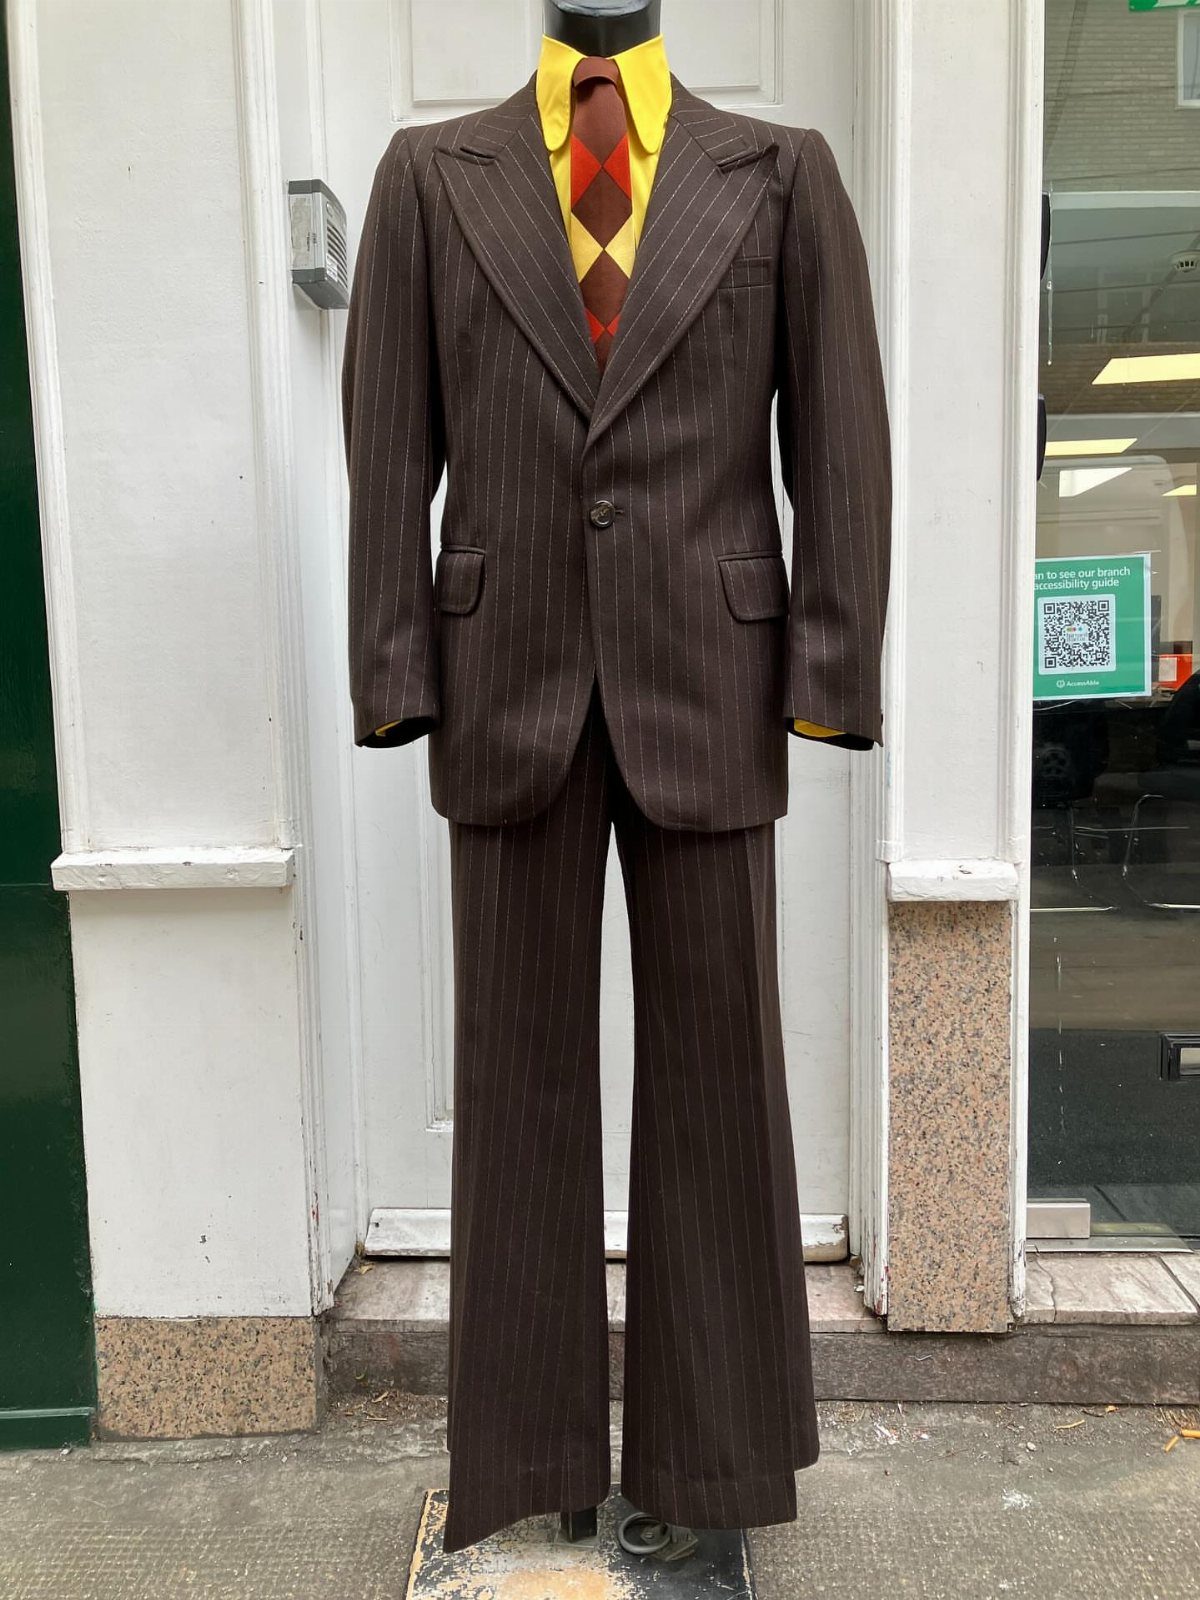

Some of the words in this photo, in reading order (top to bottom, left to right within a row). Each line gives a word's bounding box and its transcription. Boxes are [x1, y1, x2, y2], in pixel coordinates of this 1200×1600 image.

[1047, 571, 1057, 579] to
[1059, 571, 1076, 579] see
[1078, 570, 1095, 578] our
[1097, 566, 1131, 577] branch
[1034, 578, 1090, 590] accessibility
[1091, 577, 1120, 590] guide
